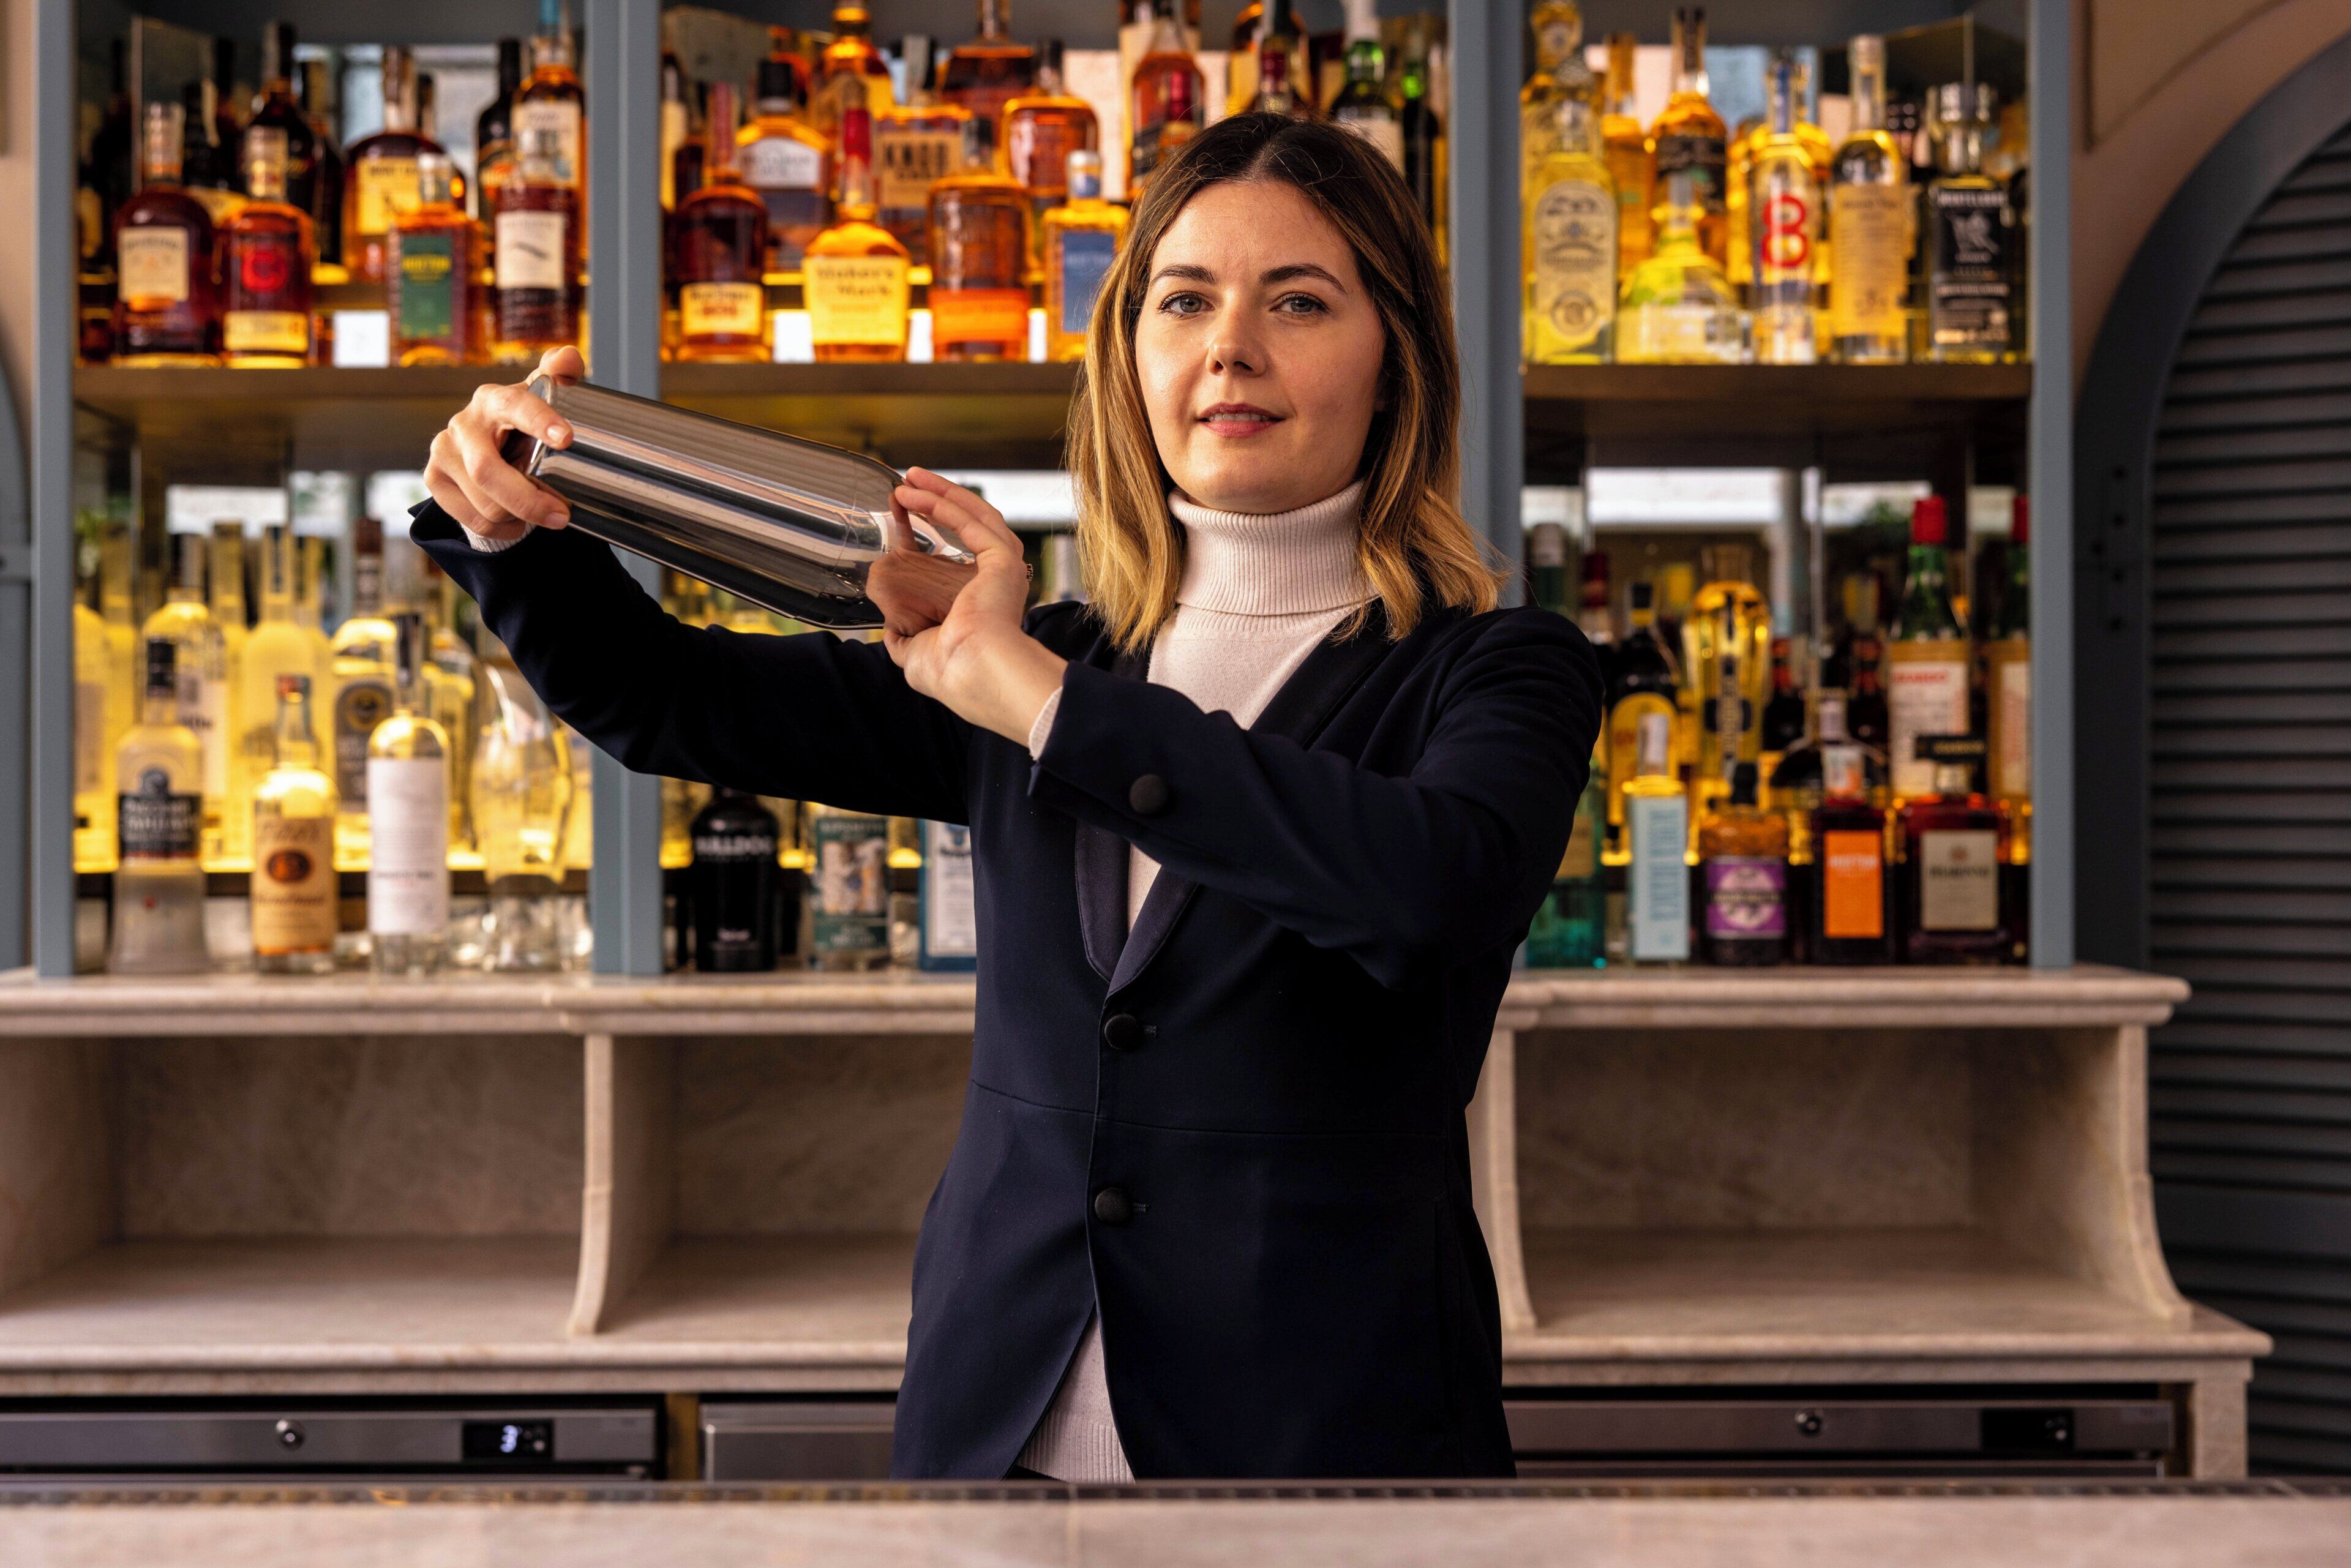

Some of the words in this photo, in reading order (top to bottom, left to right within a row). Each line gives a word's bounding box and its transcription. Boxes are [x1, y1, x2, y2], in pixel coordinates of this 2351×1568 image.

[817, 265, 894, 280] Maker's
[837, 282, 892, 298] Mark
[696, 836, 773, 854] BULLDOG
